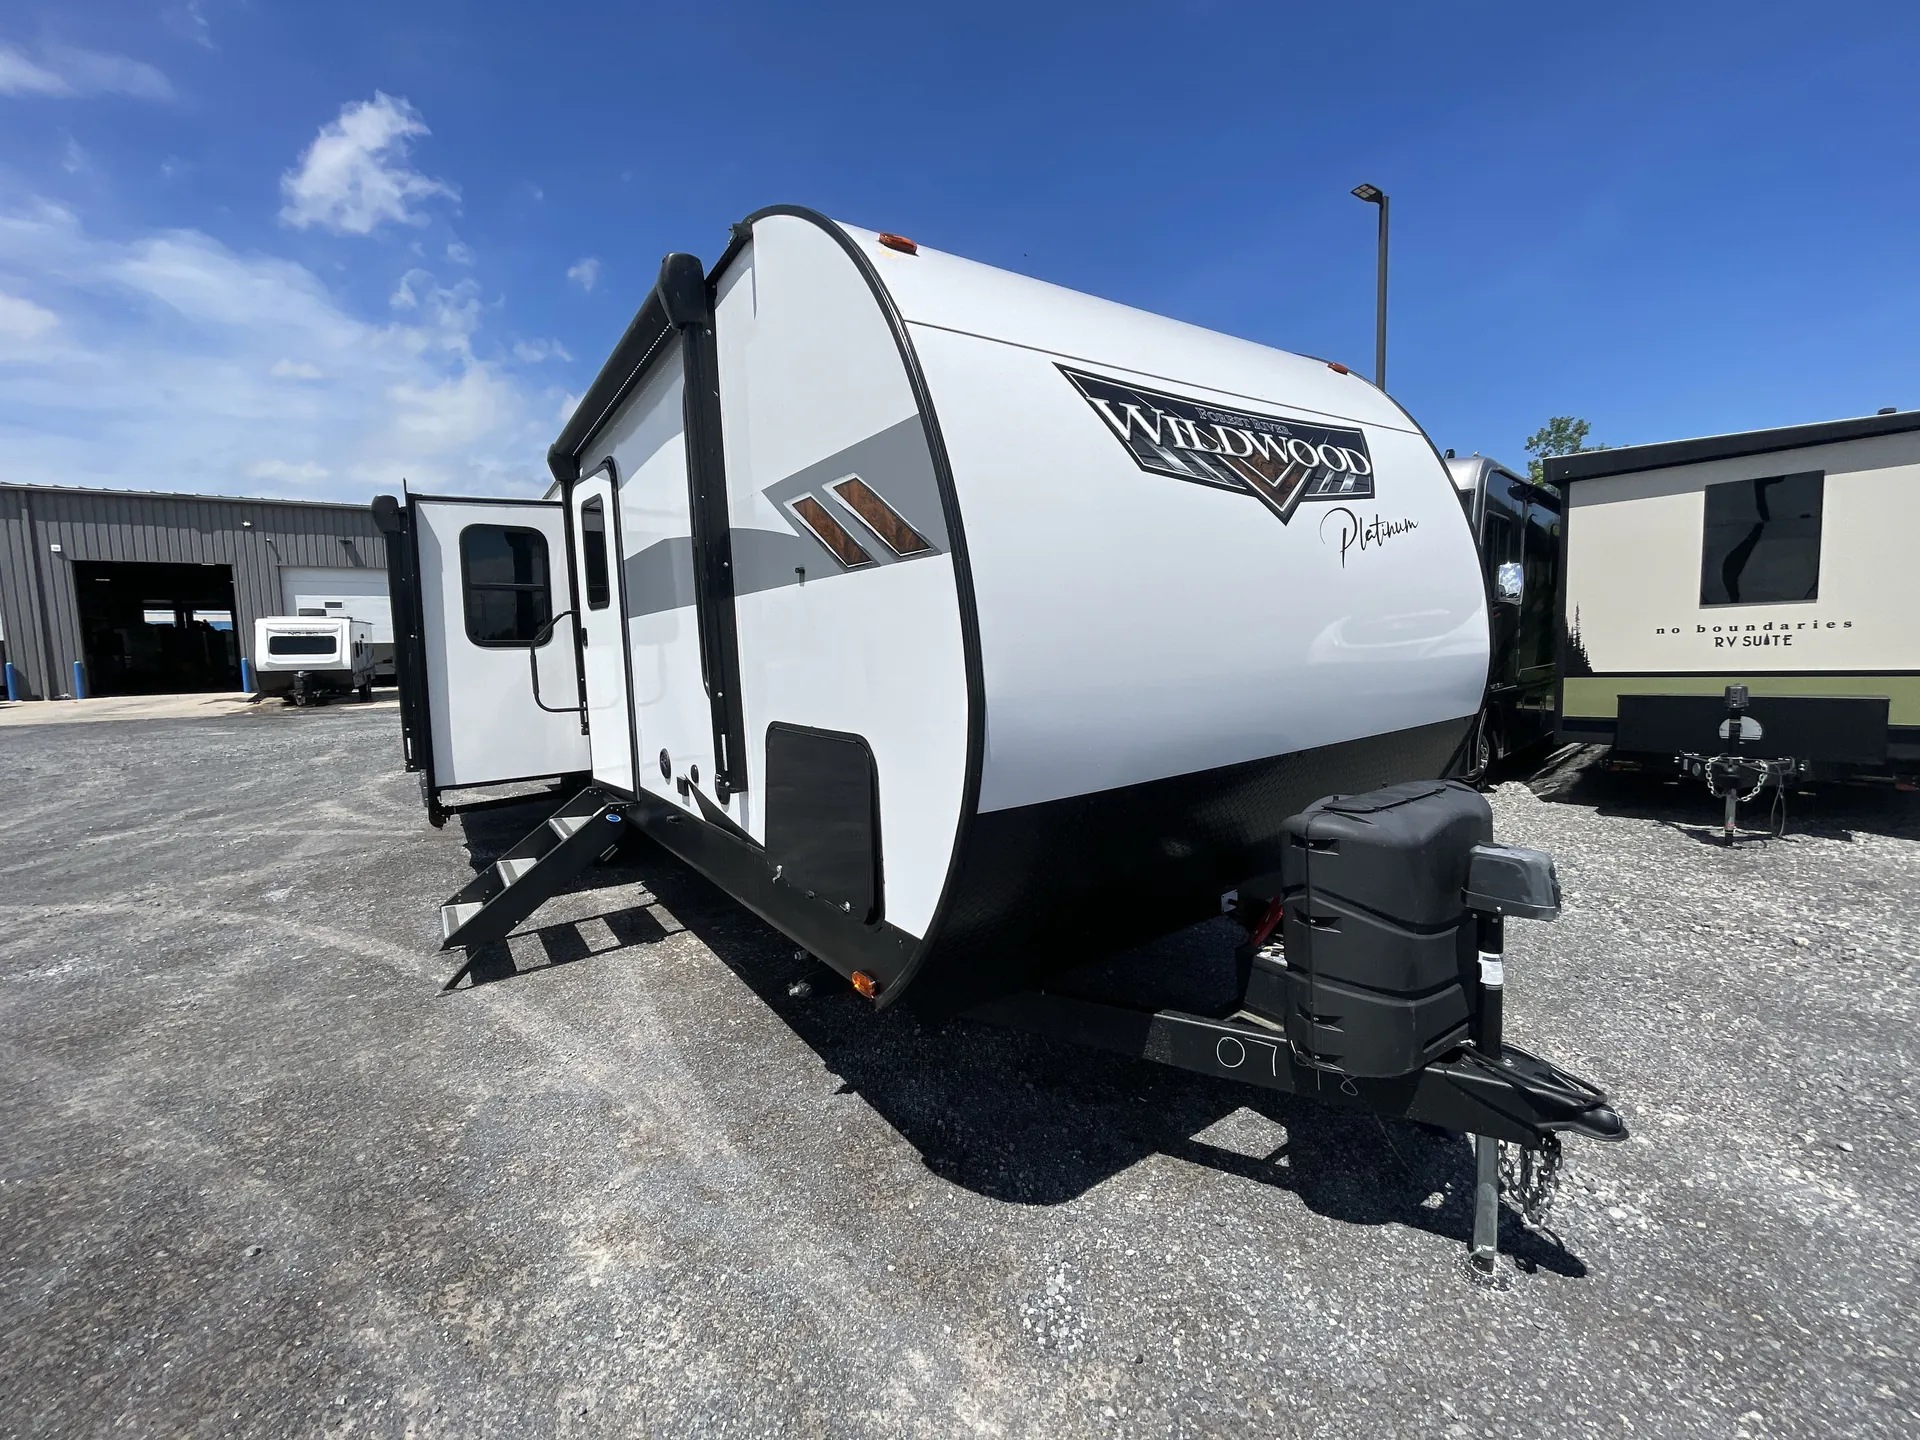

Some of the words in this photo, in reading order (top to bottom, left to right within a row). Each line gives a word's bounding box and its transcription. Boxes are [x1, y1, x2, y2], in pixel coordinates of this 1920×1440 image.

[1086, 396, 1372, 476] WILDWOOD
[1194, 406, 1251, 428] FOREST
[1249, 418, 1293, 436] RIVER
[1319, 507, 1419, 569] Platinum
[1655, 626, 1681, 635] no
[1696, 619, 1853, 634] boundaries
[1714, 636, 1738, 648] RV
